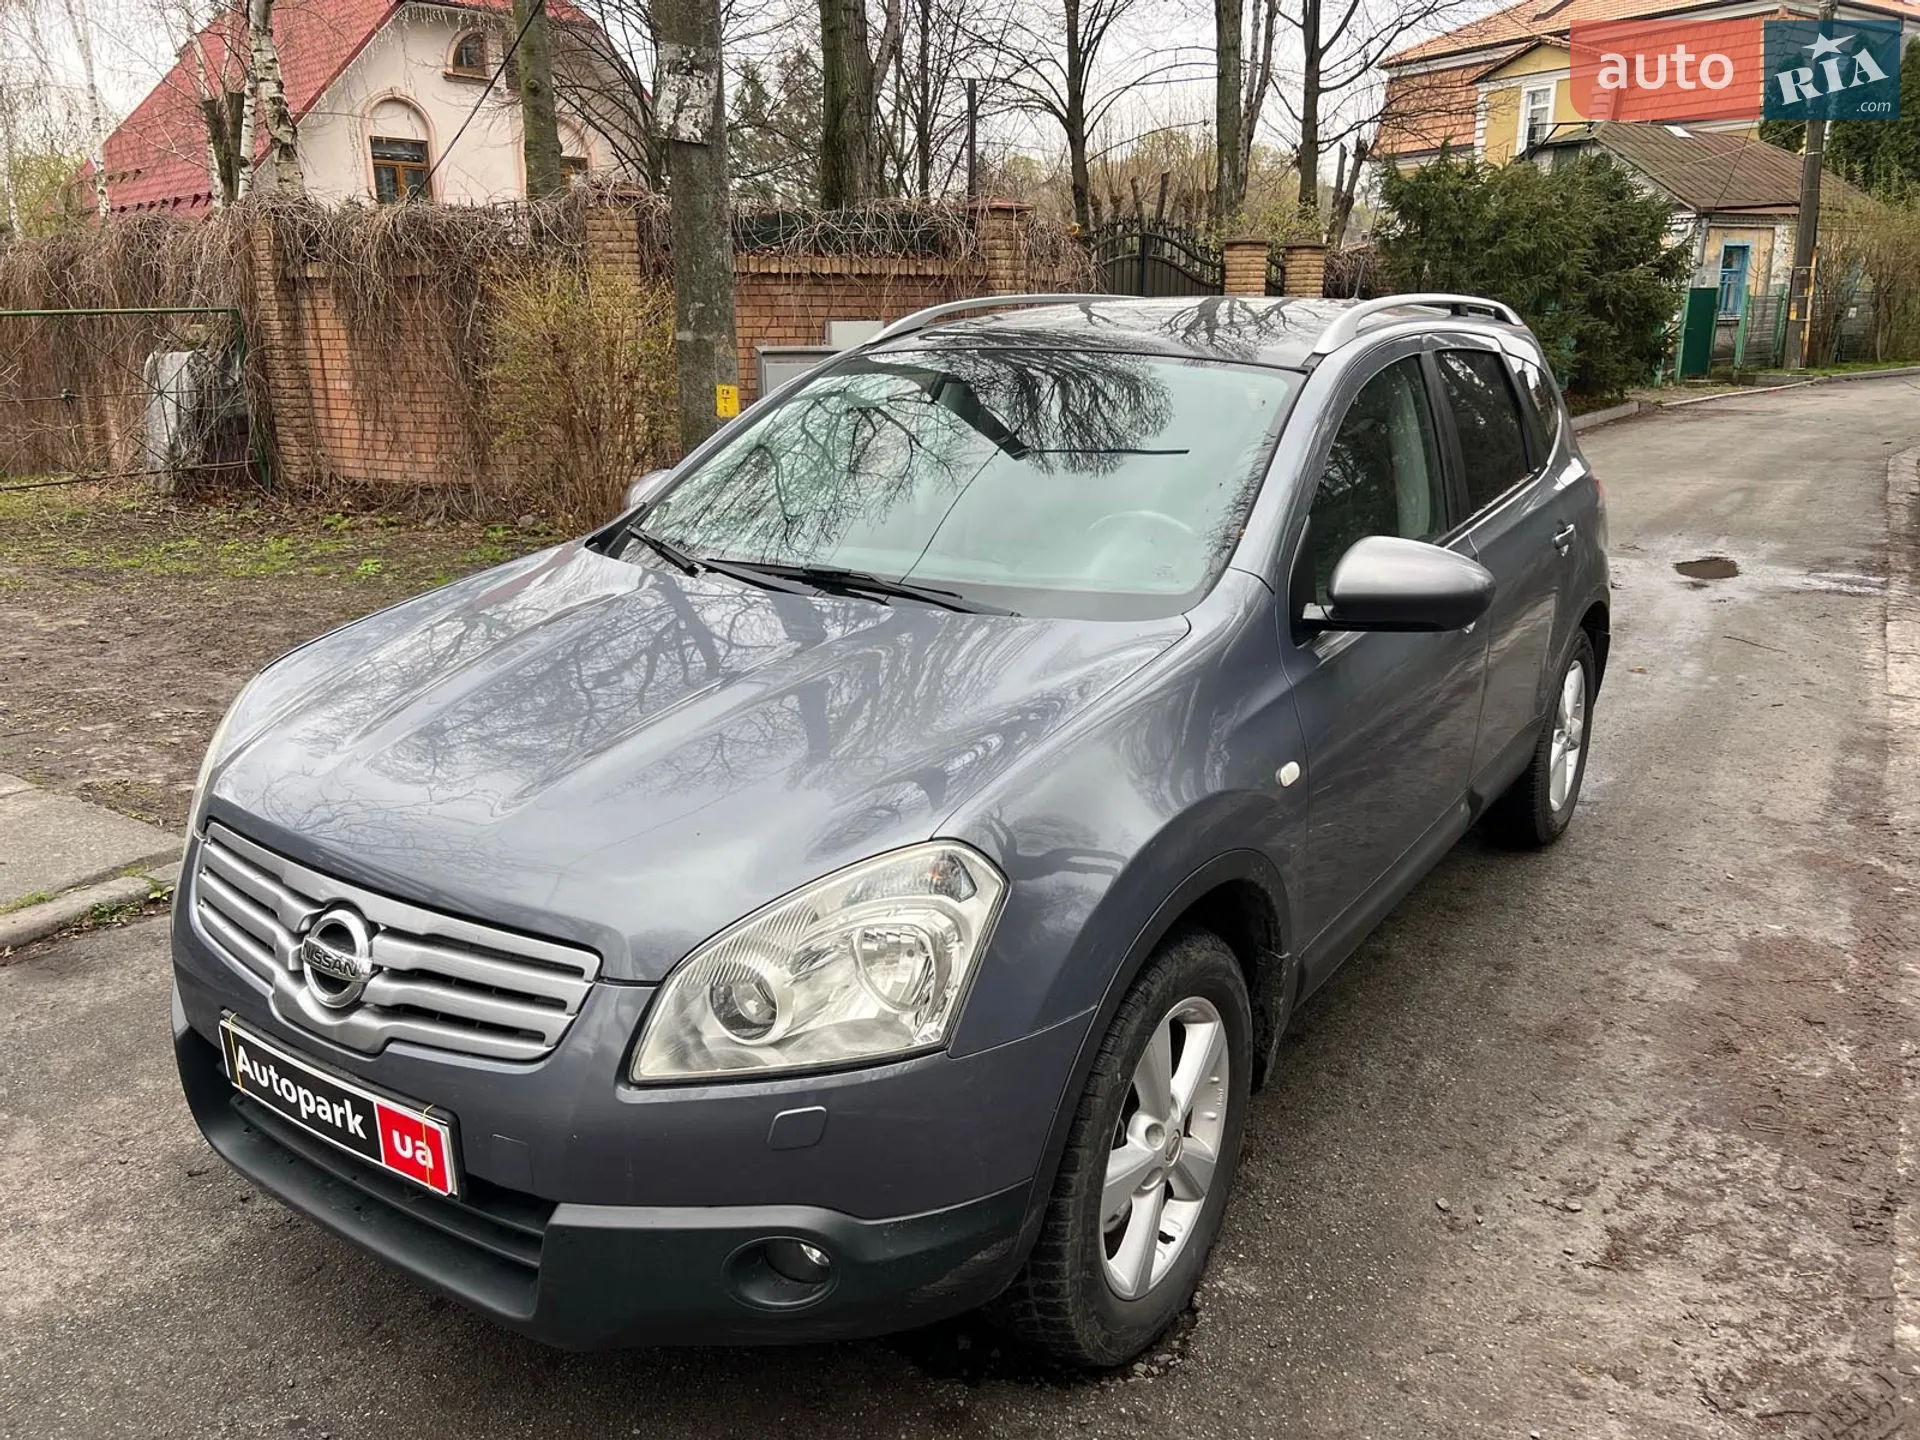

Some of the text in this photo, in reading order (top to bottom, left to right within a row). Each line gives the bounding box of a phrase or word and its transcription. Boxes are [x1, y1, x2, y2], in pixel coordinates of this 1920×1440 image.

[304, 942, 358, 977] NISSAN
[237, 1045, 434, 1169] Autopark ua
